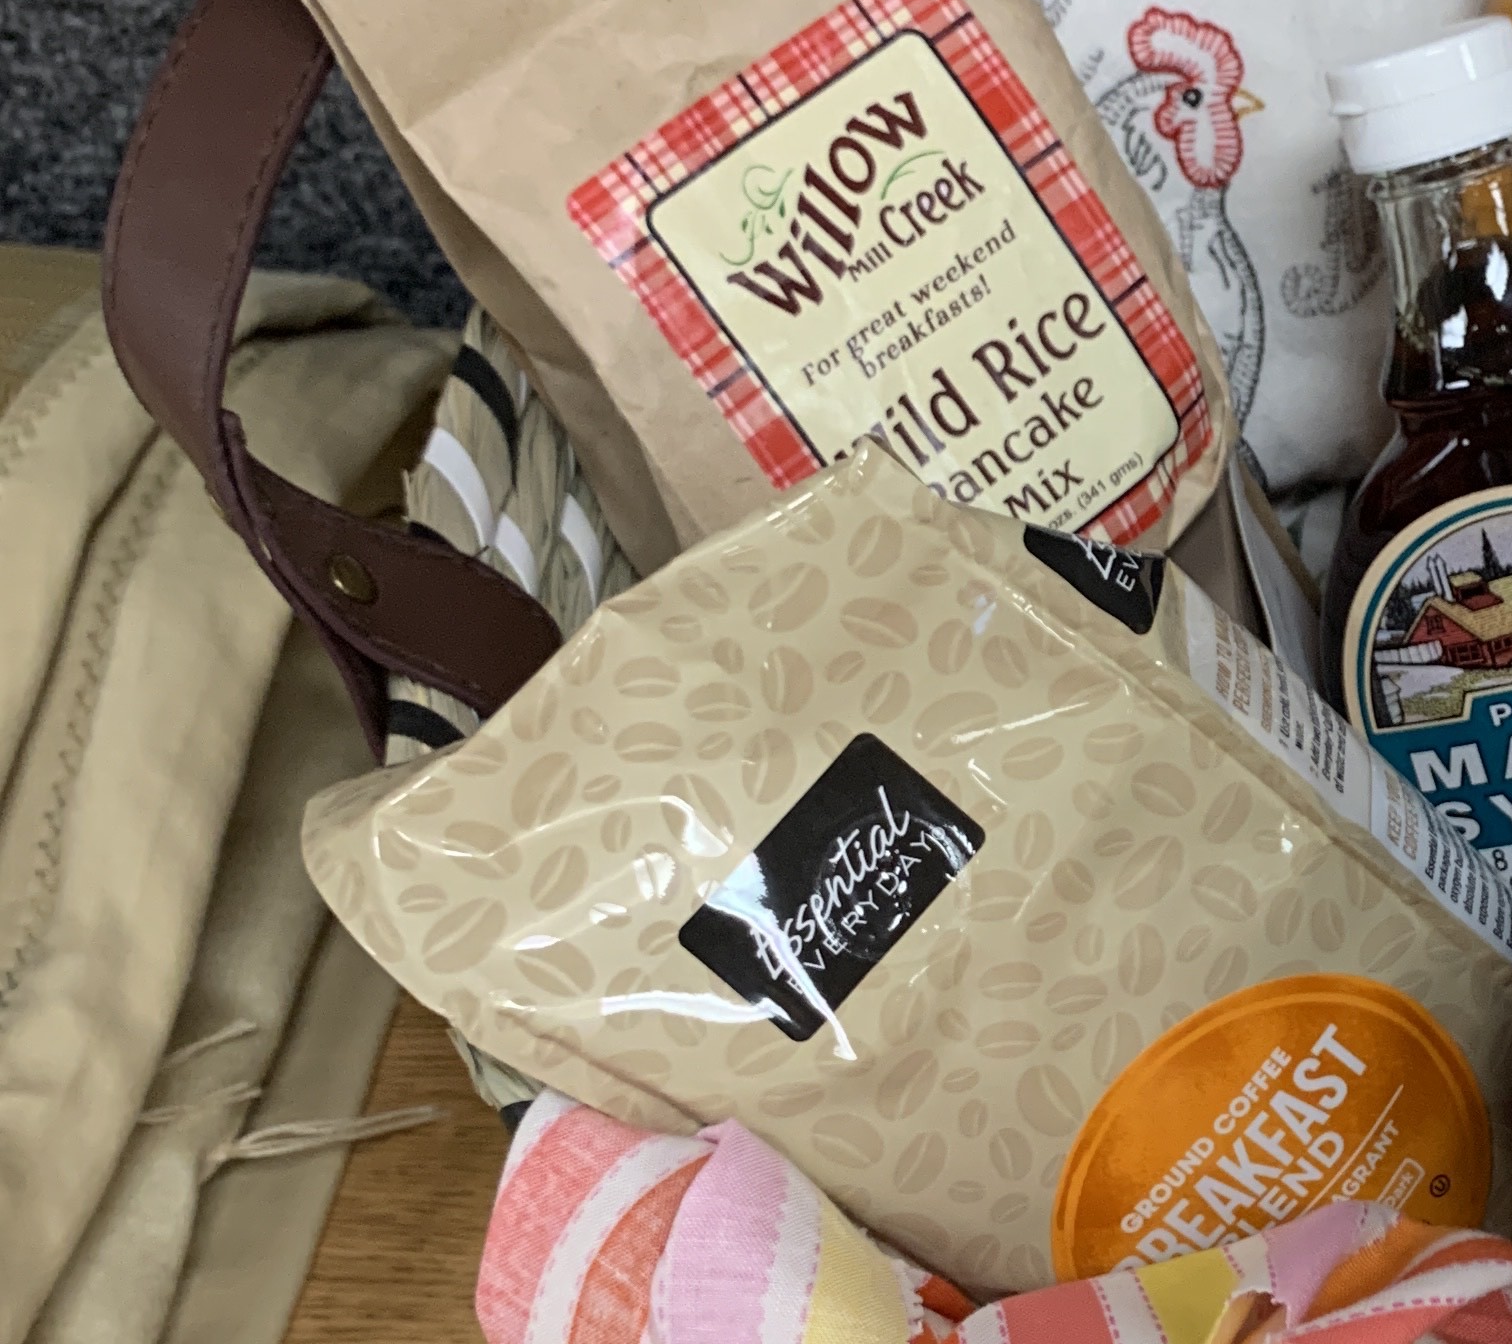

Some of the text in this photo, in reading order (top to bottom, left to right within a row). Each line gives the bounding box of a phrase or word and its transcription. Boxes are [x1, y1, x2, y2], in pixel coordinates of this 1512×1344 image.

[726, 90, 928, 318] Willow
[847, 157, 985, 283] Mill Creek
[800, 218, 1018, 387] For great weekend
[856, 273, 992, 380] breakfasts!
[832, 288, 1107, 469] ild Rice
[1002, 458, 1085, 520] Mix
[1109, 452, 1145, 486] gms)
[1491, 849, 1508, 872] 8
[1120, 1045, 1293, 1235] GROUND COFFEE
